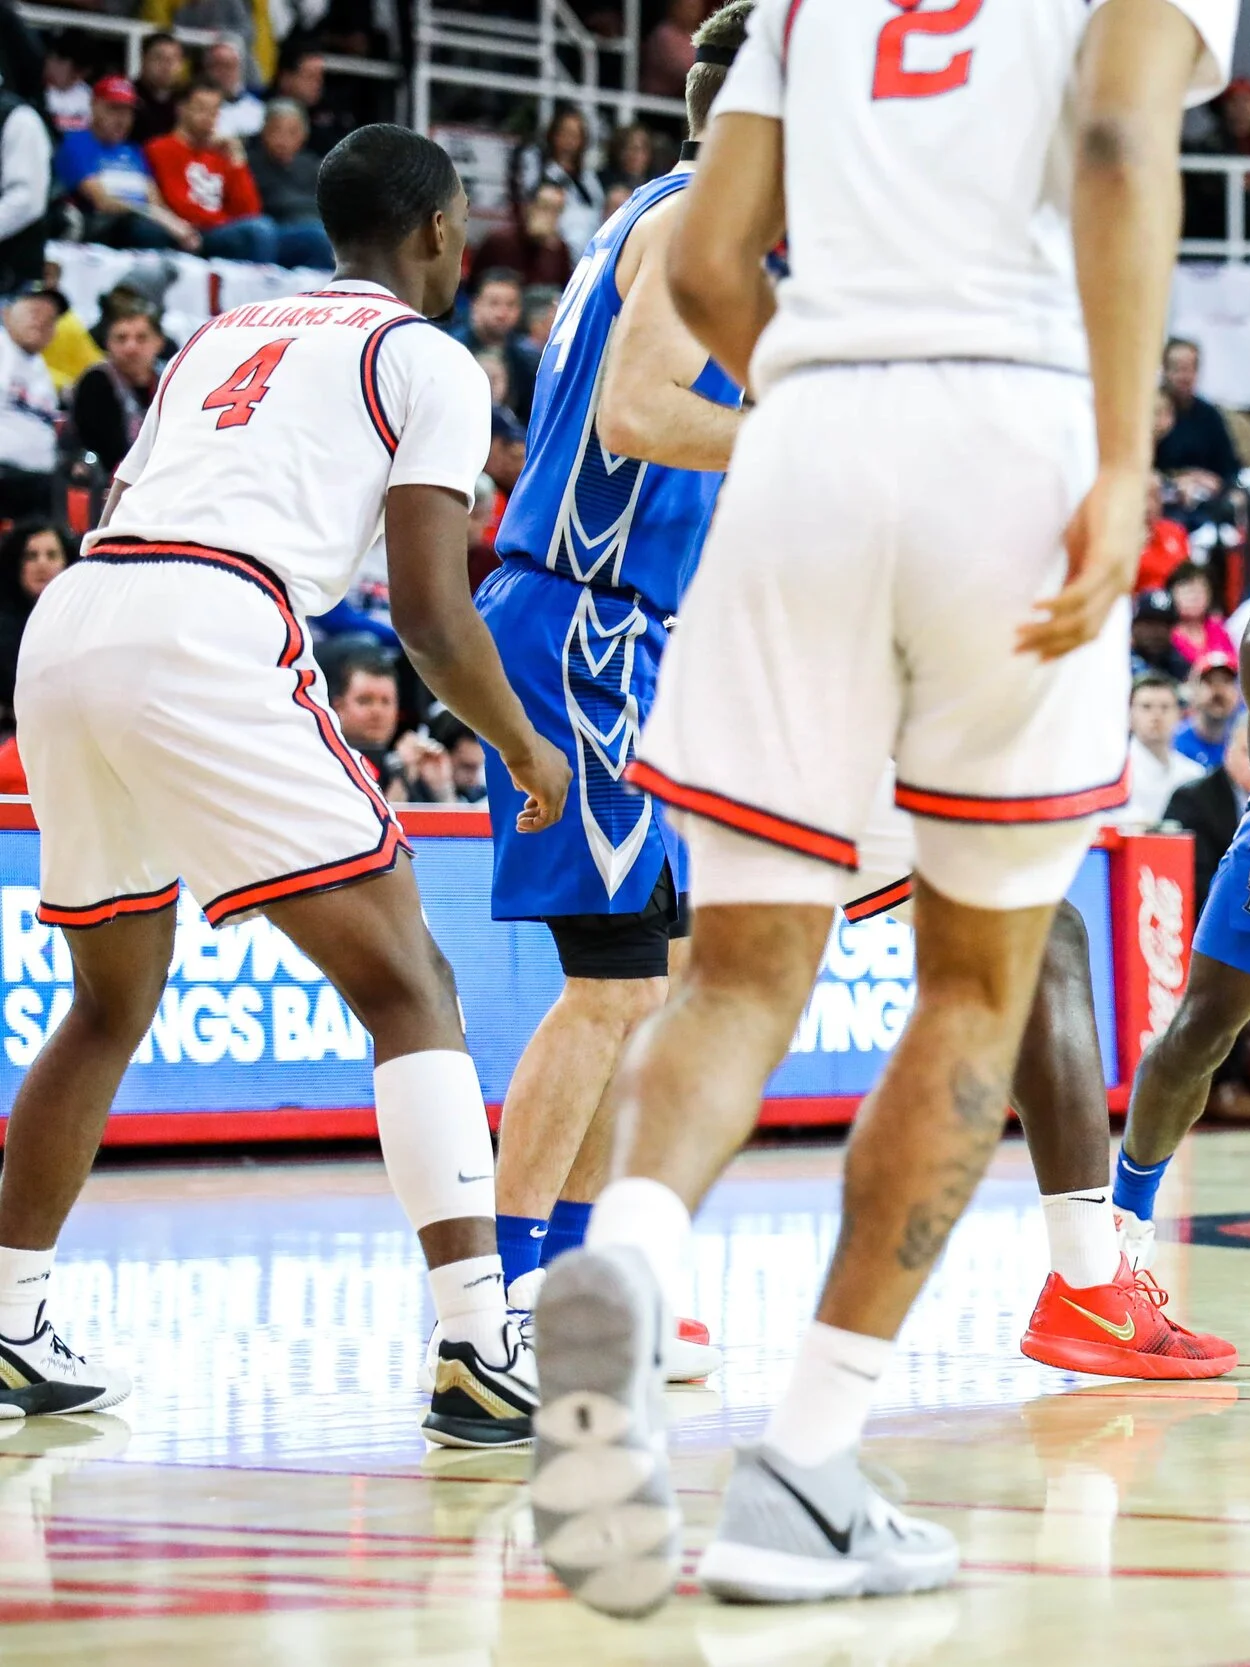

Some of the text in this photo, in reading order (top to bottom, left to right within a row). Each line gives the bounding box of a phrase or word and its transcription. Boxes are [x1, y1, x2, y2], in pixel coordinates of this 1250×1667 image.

[871, 0, 986, 101] 2
[214, 305, 382, 331] WILLIAMS JR.
[202, 338, 299, 431] 4
